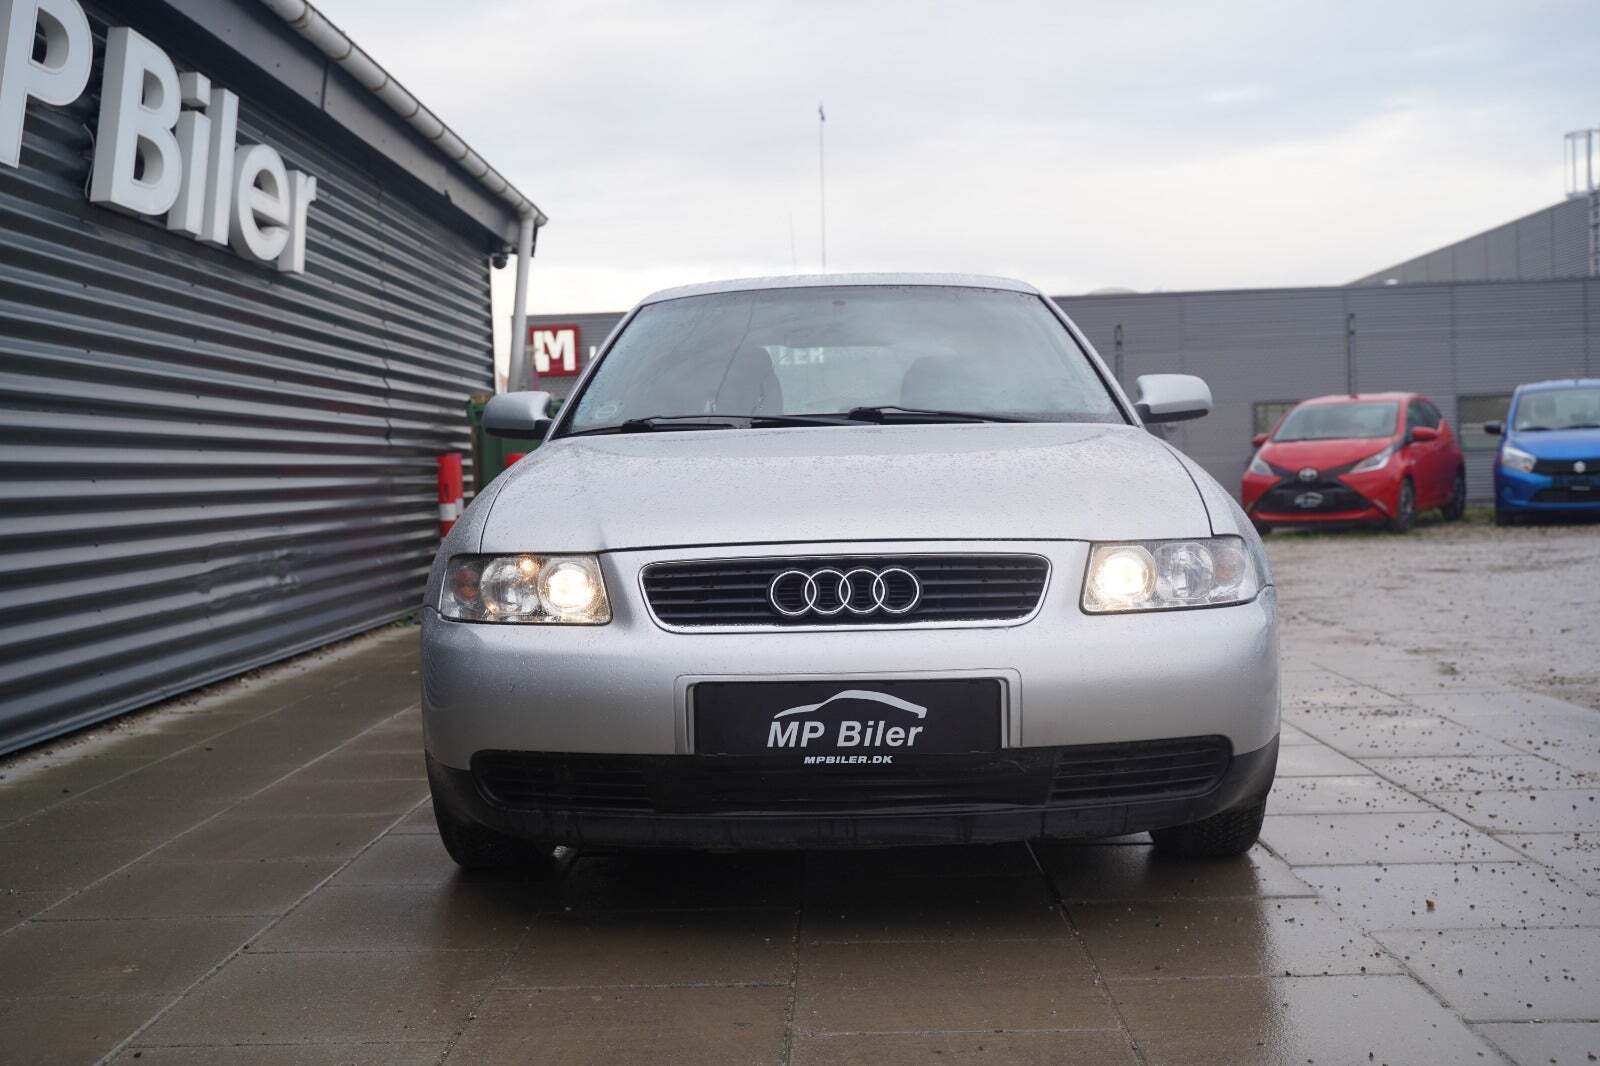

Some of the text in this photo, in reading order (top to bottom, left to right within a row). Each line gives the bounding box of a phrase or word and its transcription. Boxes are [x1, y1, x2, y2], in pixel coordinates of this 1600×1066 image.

[90, 26, 317, 273] Biler
[767, 720, 924, 748] MP Biler
[804, 755, 893, 764] MPBILER.DK
